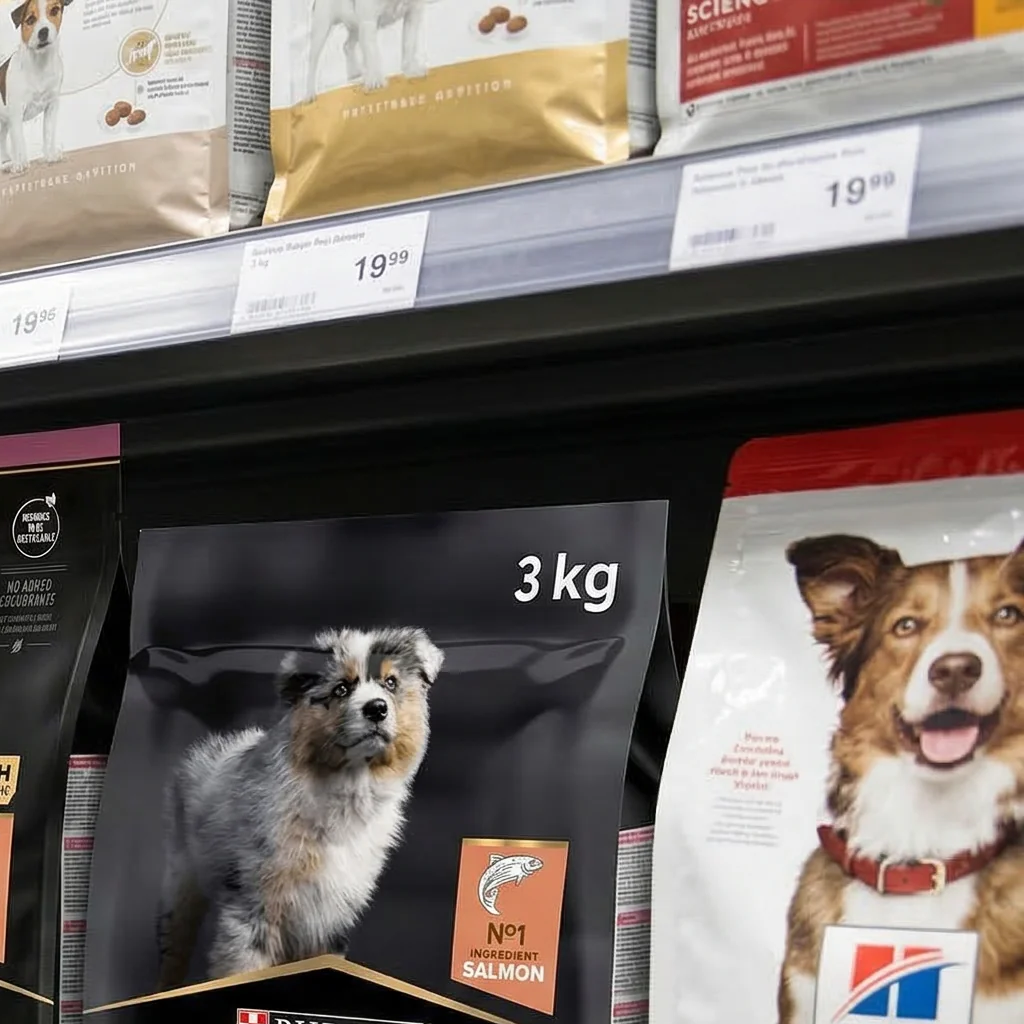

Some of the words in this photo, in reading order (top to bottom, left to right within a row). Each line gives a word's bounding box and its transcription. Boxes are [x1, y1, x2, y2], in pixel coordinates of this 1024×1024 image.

[514, 555, 541, 603] 3
[552, 552, 619, 613] kg
[470, 948, 539, 962] INGREDIENT
[462, 961, 544, 983] SALMON
